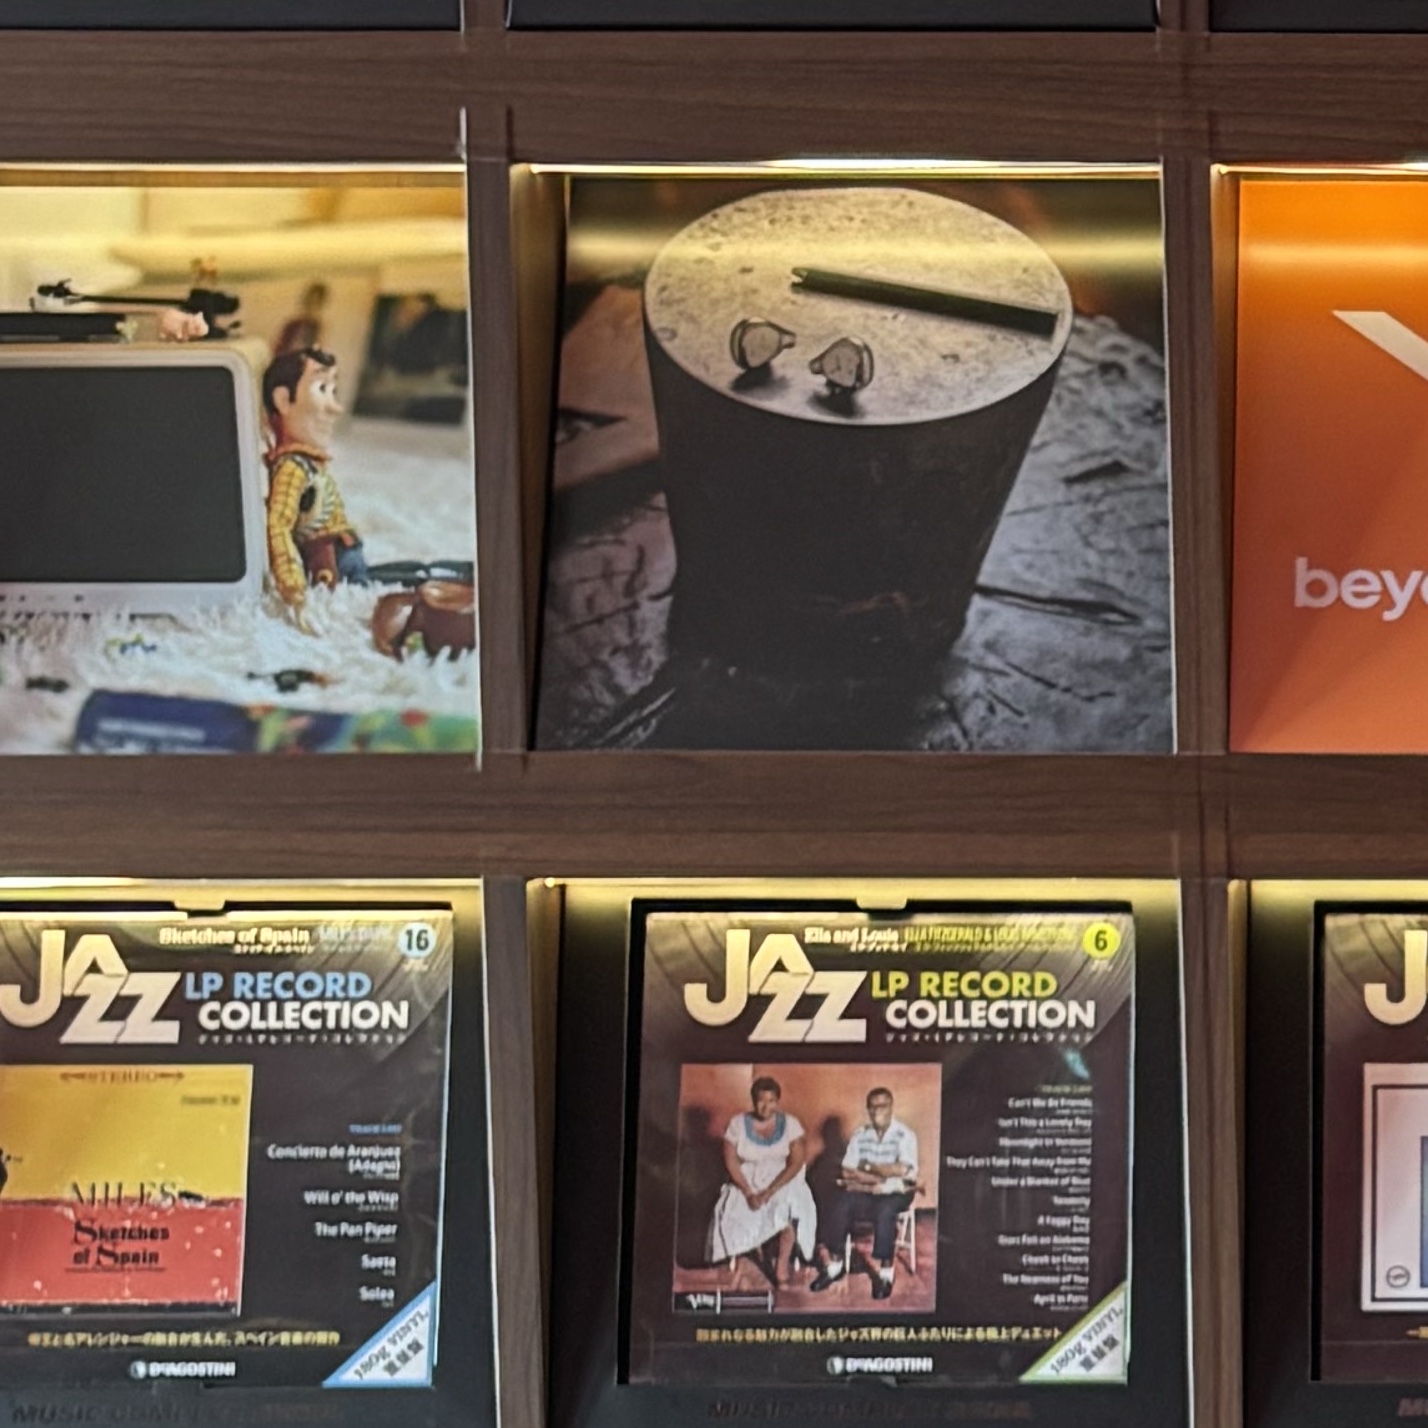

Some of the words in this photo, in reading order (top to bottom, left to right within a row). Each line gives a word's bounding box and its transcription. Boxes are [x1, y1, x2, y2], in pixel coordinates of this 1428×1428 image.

[238, 929, 258, 944] of
[260, 927, 310, 946] Spain
[405, 929, 429, 951] 16
[1094, 930, 1108, 952] 6
[0, 929, 181, 1044] JAZZ
[185, 972, 224, 1000] LP
[234, 972, 372, 1000] RECORD
[684, 928, 868, 1043] JAZZ
[871, 972, 909, 998] LP
[920, 971, 1058, 998] RECORD
[199, 1001, 409, 1030] COLLECTION
[885, 1000, 1096, 1028] COLLECTION
[73, 1221, 169, 1245] Sketches
[73, 1248, 90, 1264] of
[96, 1245, 159, 1271] Spain
